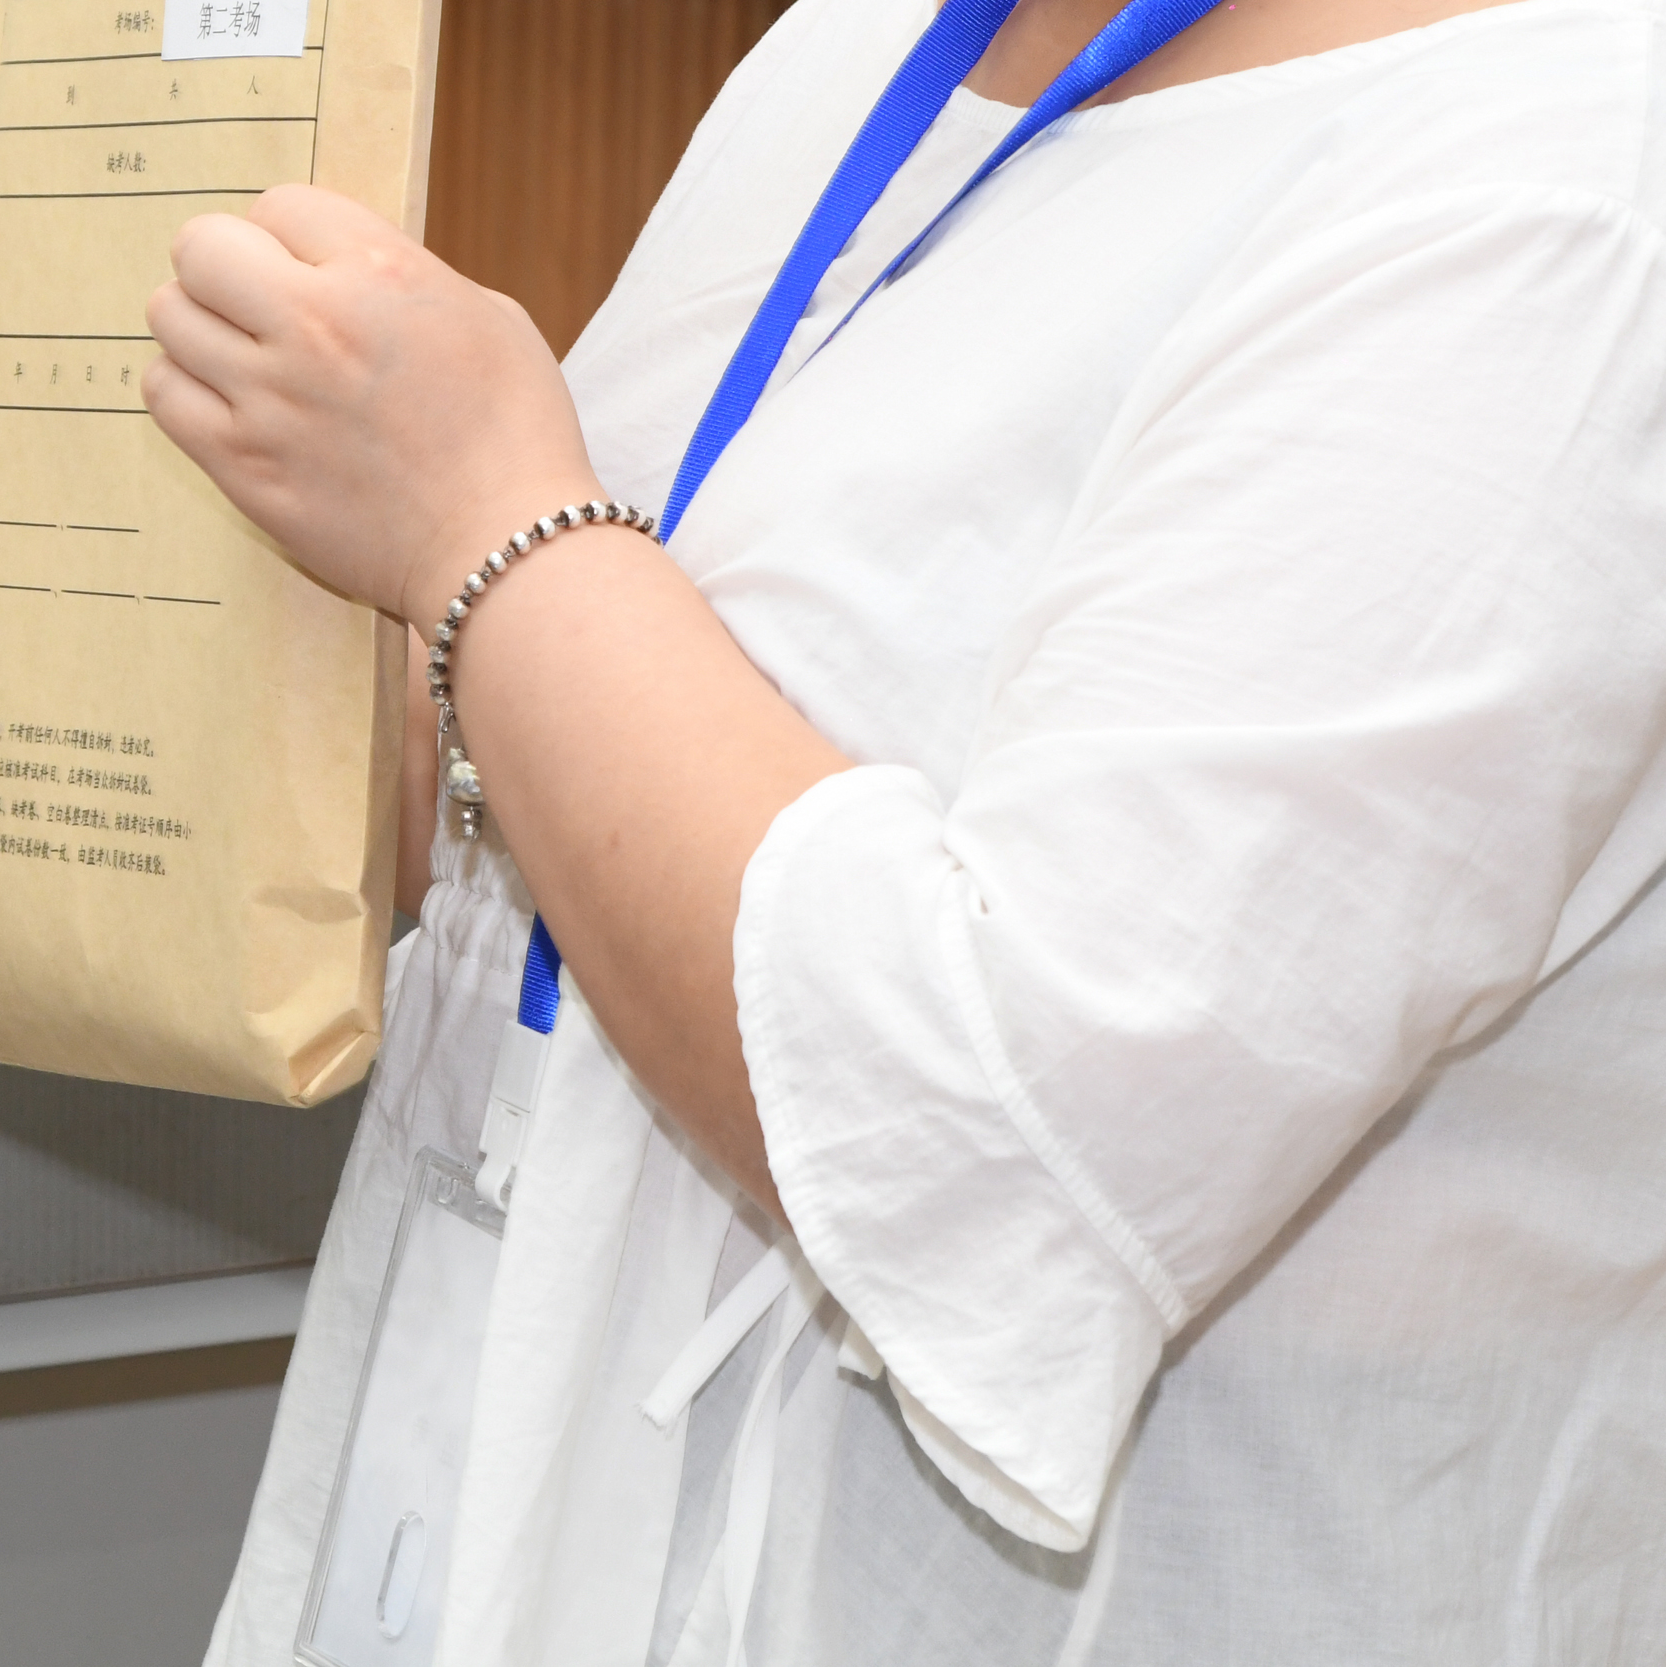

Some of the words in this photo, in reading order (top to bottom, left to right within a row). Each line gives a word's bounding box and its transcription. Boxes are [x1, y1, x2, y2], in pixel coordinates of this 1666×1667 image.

[197, 1, 261, 39] 第二考场
[247, 75, 259, 95] 人
[49, 363, 58, 385] 月
[86, 364, 93, 384] 日
